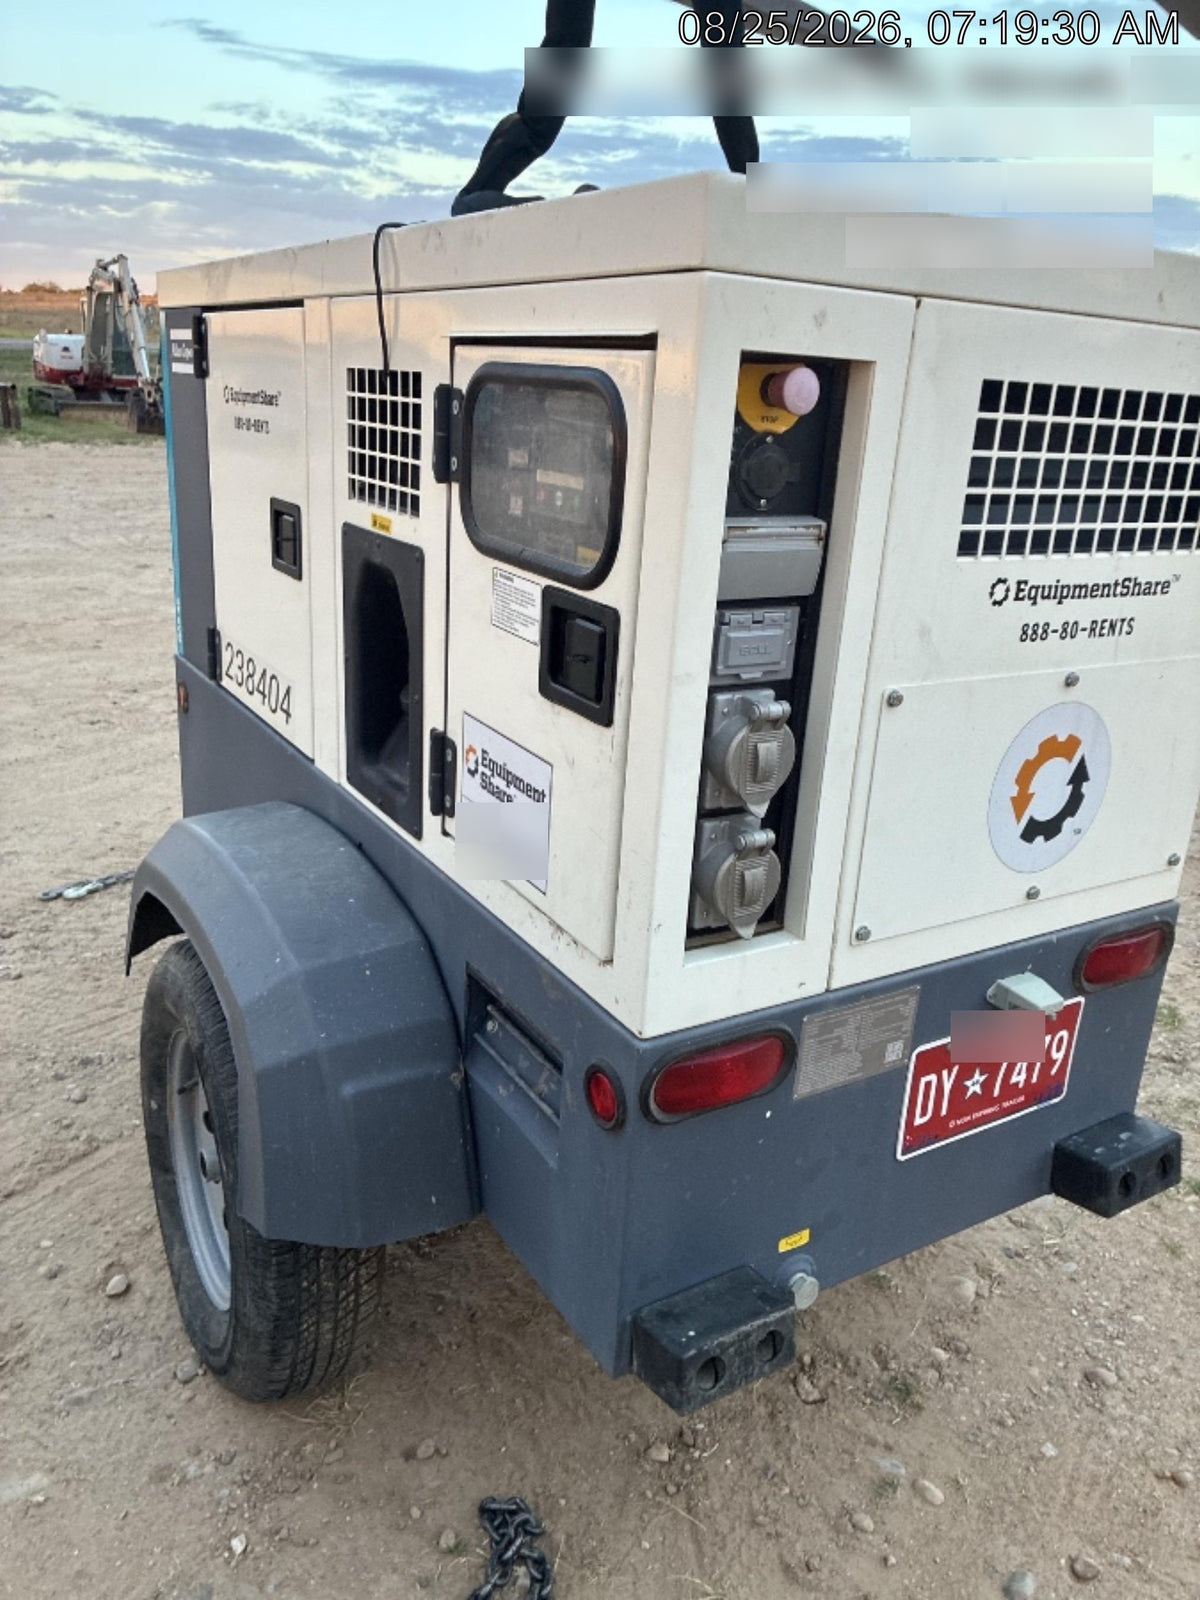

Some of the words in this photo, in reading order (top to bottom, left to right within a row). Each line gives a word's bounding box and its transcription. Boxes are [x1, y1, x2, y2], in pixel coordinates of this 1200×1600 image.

[1013, 577, 1171, 606] EquipmentShare
[1019, 617, 1136, 643] 888-80-RENTS
[224, 641, 292, 726] 238404
[479, 771, 514, 803] Share
[480, 748, 547, 803] Equipment
[914, 1064, 959, 1127] DY
